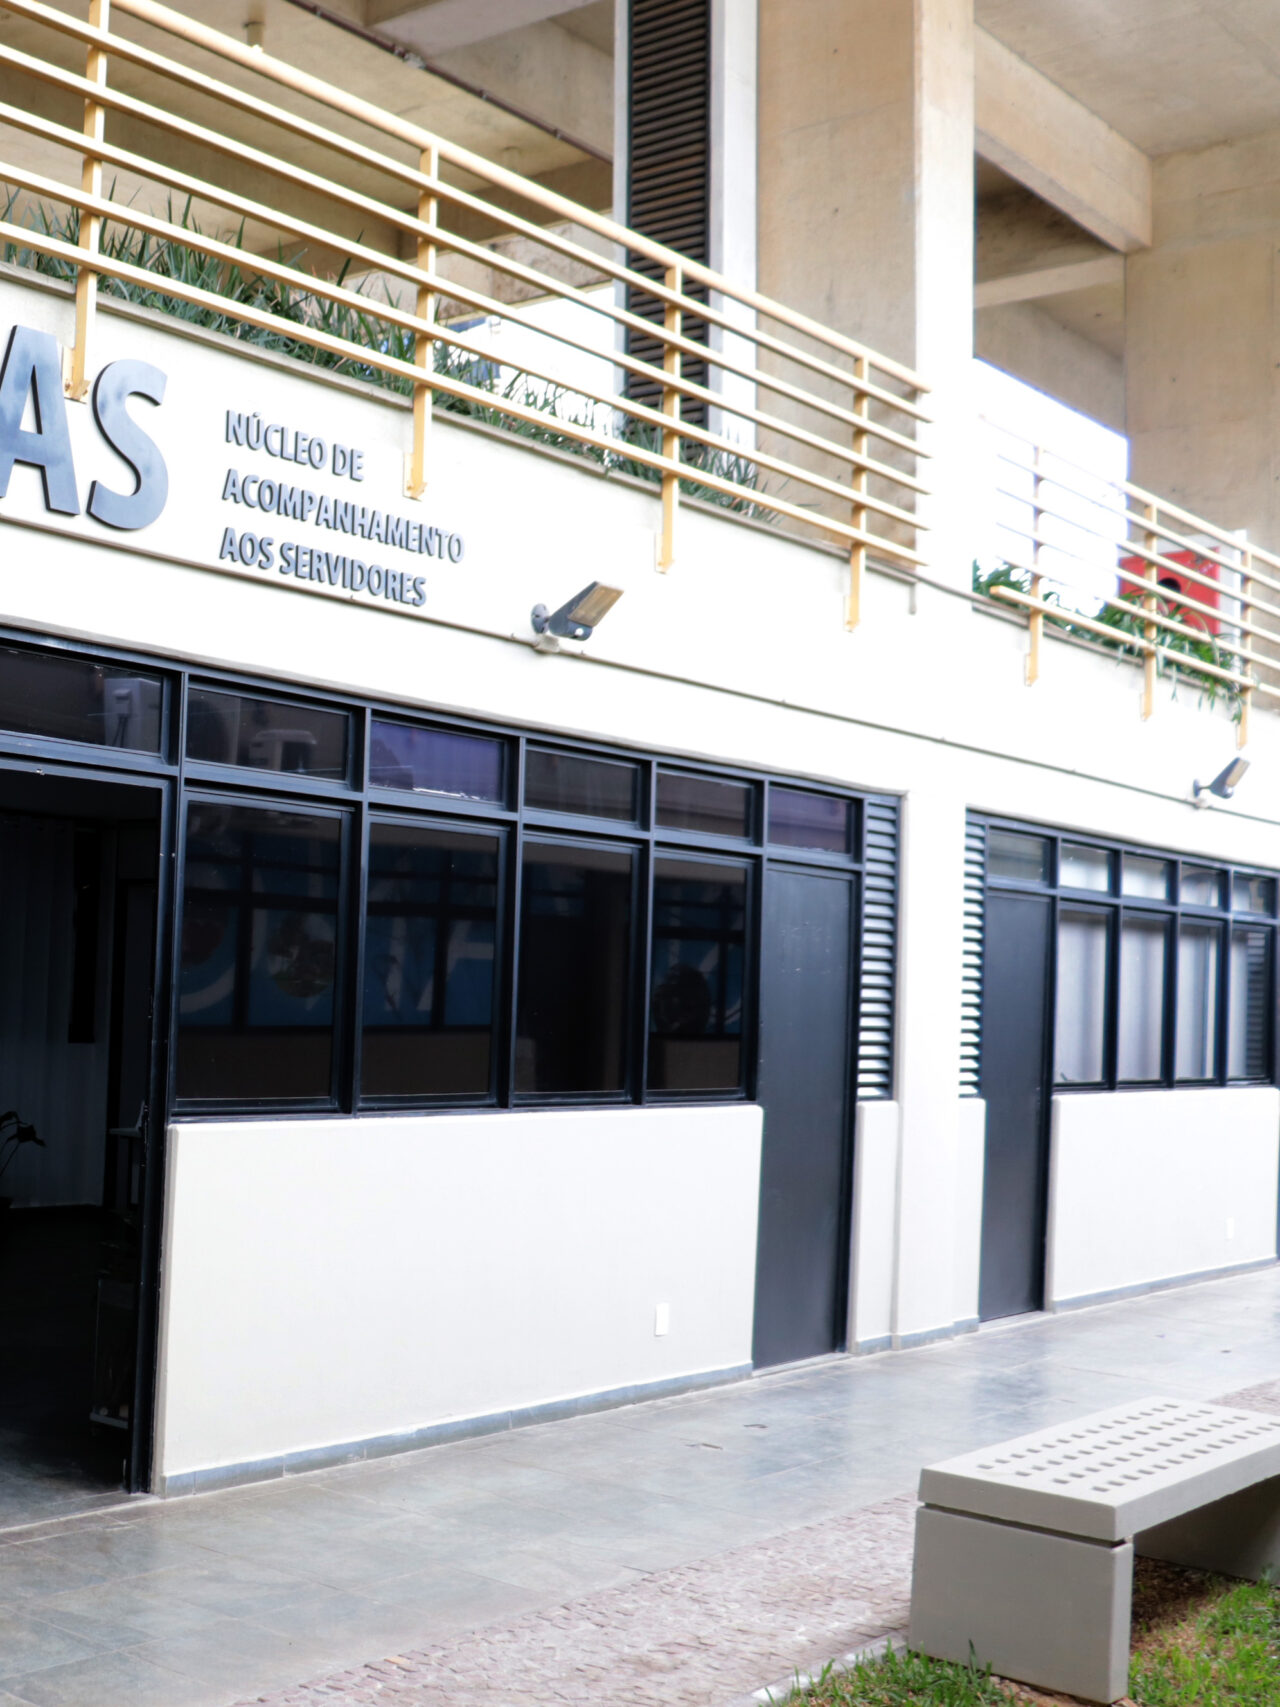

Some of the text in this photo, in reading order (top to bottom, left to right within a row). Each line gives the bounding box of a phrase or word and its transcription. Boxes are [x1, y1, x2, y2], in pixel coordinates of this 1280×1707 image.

[225, 409, 364, 482] NÚCLEO DE
[222, 468, 465, 563] ACOMPANHAMENTO
[219, 526, 428, 606] AOS SERVIDORES
